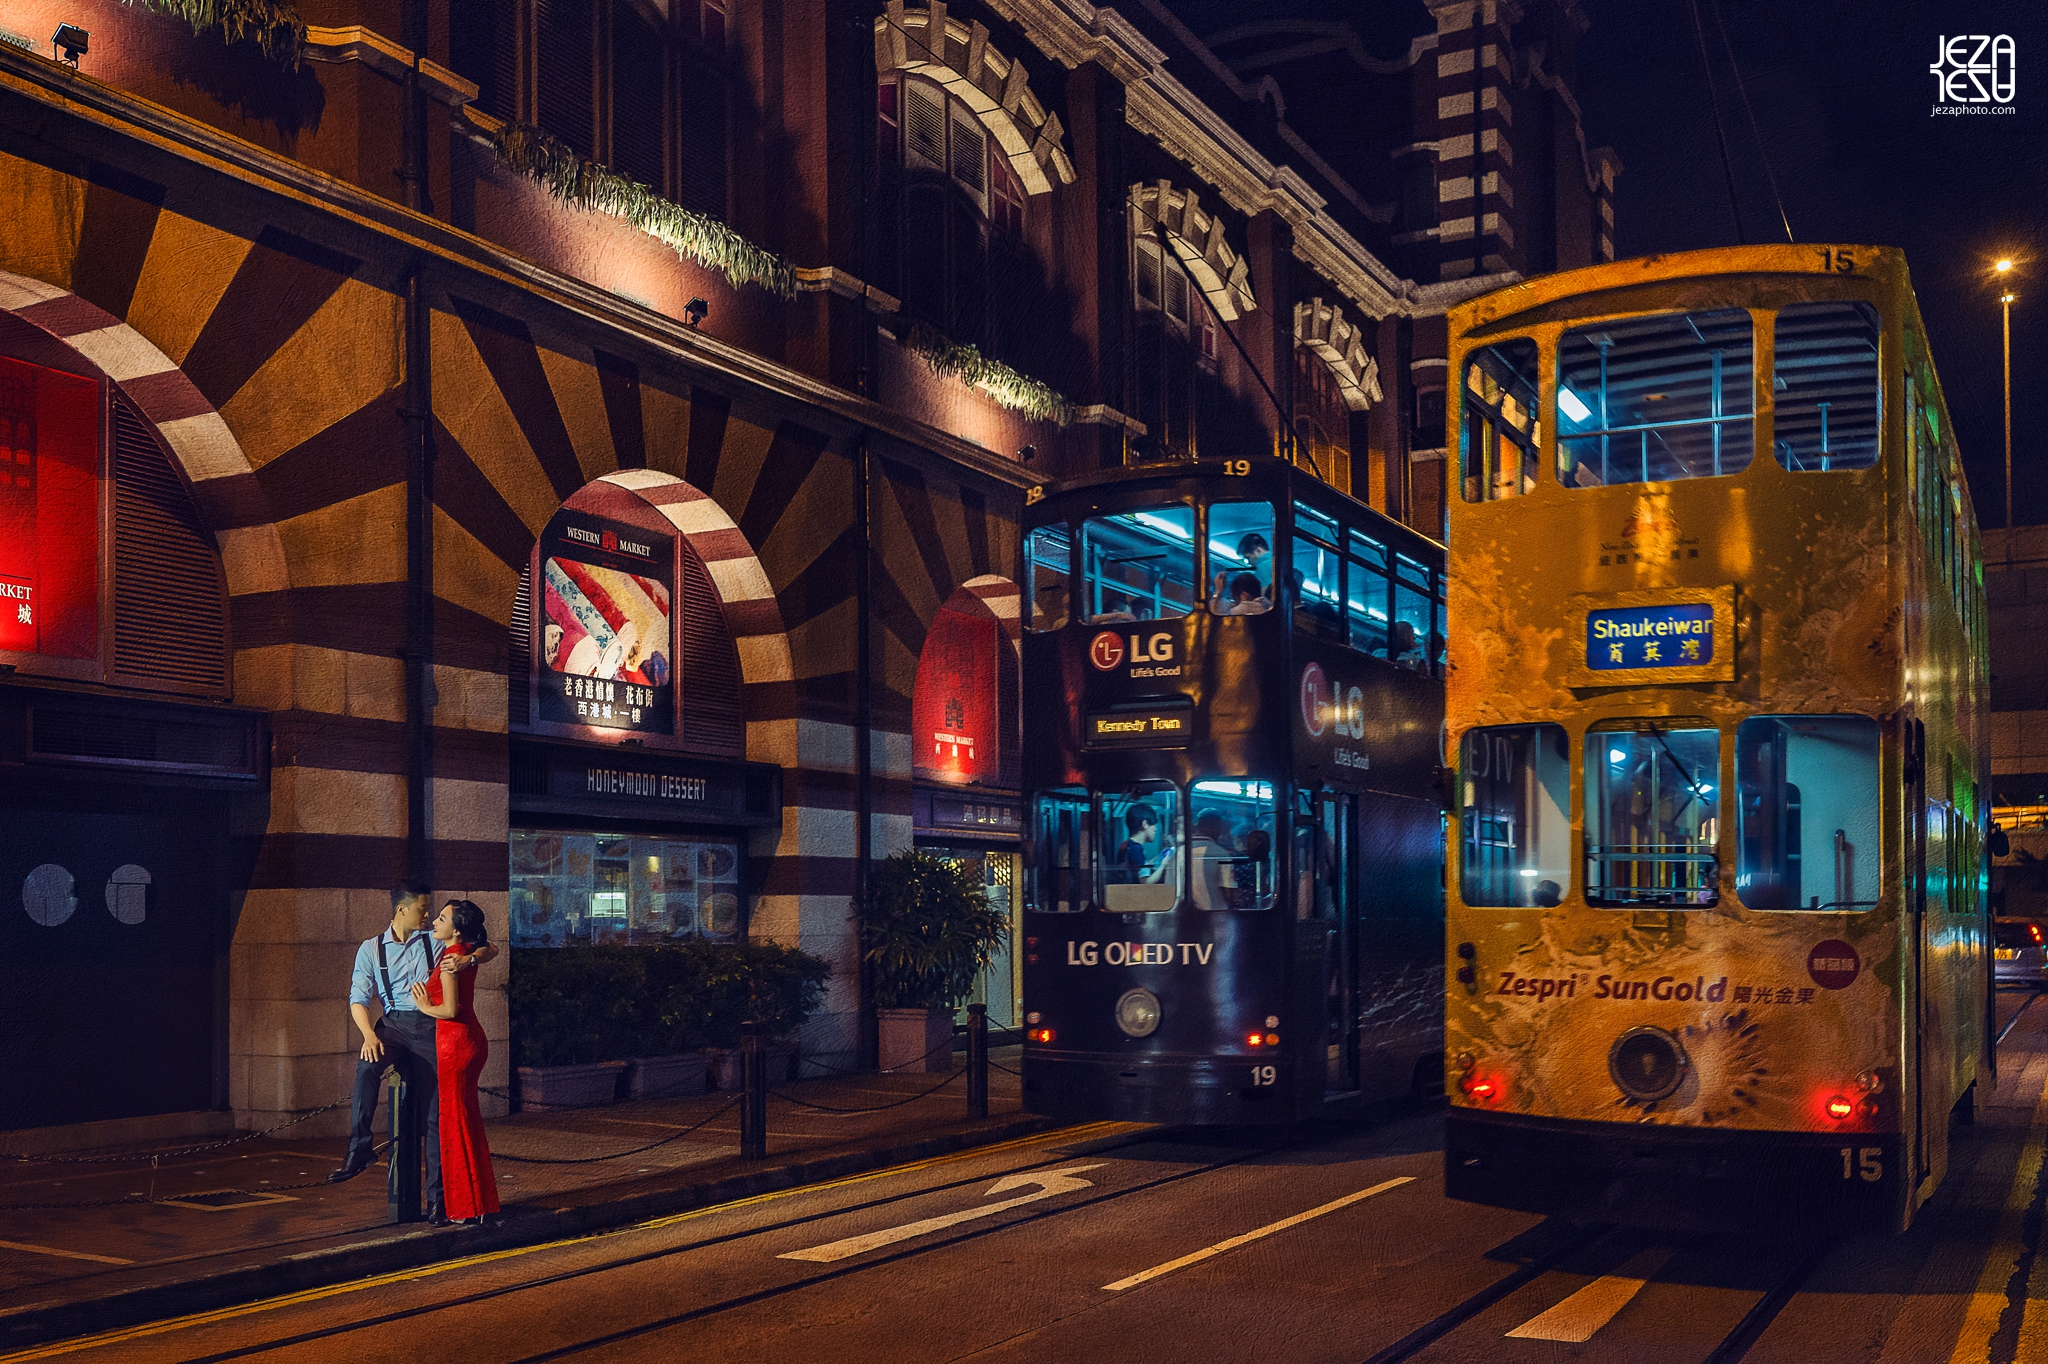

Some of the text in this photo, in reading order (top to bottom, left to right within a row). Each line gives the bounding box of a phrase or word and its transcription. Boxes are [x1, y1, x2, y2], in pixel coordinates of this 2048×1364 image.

[1817, 250, 1855, 273] 15
[1223, 459, 1251, 477] 19
[567, 526, 651, 557] WESTERN MARKET
[17, 603, 33, 625] 城
[1130, 632, 1174, 663] LG
[1130, 666, 1181, 678] Life's Good
[1334, 681, 1364, 739] LG
[1097, 717, 1182, 733] Kennedy Town
[1352, 751, 1370, 770] Good
[587, 768, 706, 800] HONEYMOON DESSERT
[1067, 941, 1214, 967] LG OLED TV
[1595, 974, 1728, 1003] SunGold
[1733, 986, 1815, 1005] 陽光金果
[1251, 1065, 1277, 1086] 19
[1841, 1147, 1882, 1182] 15
